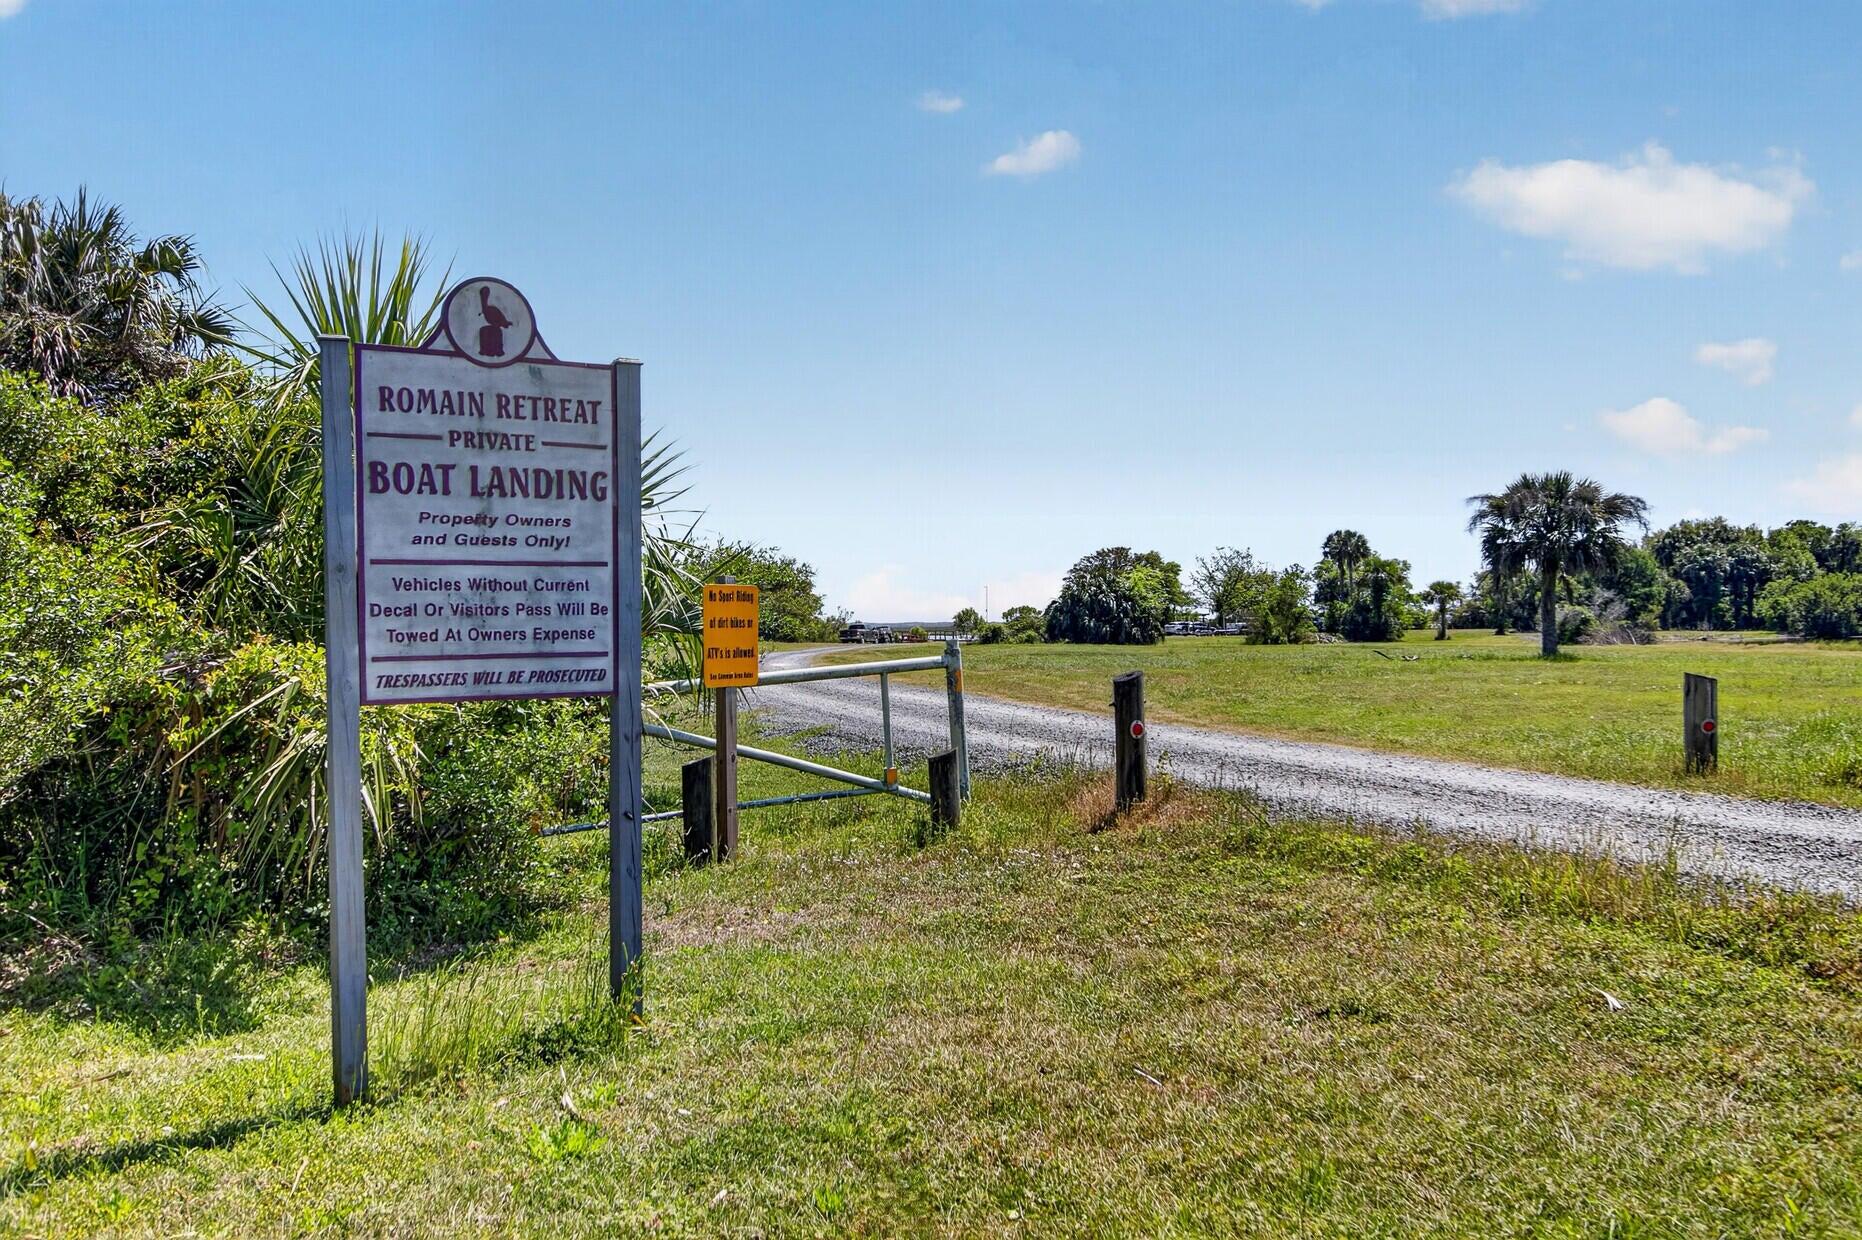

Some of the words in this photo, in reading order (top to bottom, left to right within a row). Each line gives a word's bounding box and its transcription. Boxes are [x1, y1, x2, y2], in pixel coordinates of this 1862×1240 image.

[378, 385, 485, 417] ROMAIN
[496, 394, 602, 424] RETREAT
[448, 430, 536, 451] PRIVATE
[368, 461, 456, 495] BOAT
[470, 465, 607, 502] LANDING
[419, 512, 499, 528] Property
[506, 514, 571, 527] Owners
[412, 534, 446, 545] and
[455, 534, 517, 546] Guests
[525, 535, 570, 550] Only!
[392, 577, 461, 592] Vehicles
[468, 578, 527, 592] Without
[534, 578, 589, 592] Current
[709, 590, 716, 601] No
[736, 590, 753, 604] Riding
[370, 603, 417, 617] Decal
[425, 603, 444, 617] Or
[450, 603, 509, 616] Visitors
[516, 603, 551, 616] Pass
[557, 603, 584, 616] Will
[591, 603, 608, 615] Be
[710, 618, 715, 628] of
[718, 617, 728, 628] dirt
[730, 617, 745, 628] bikes
[747, 619, 753, 628] or
[387, 629, 438, 642] Towed
[445, 629, 461, 642] At
[468, 628, 526, 641] Owners
[533, 627, 595, 643] Expense
[725, 648, 730, 658] is
[376, 672, 468, 688] TRESPASSERS
[473, 671, 502, 686] WILL
[507, 670, 525, 684] BE
[528, 668, 607, 684] PROSECUTED
